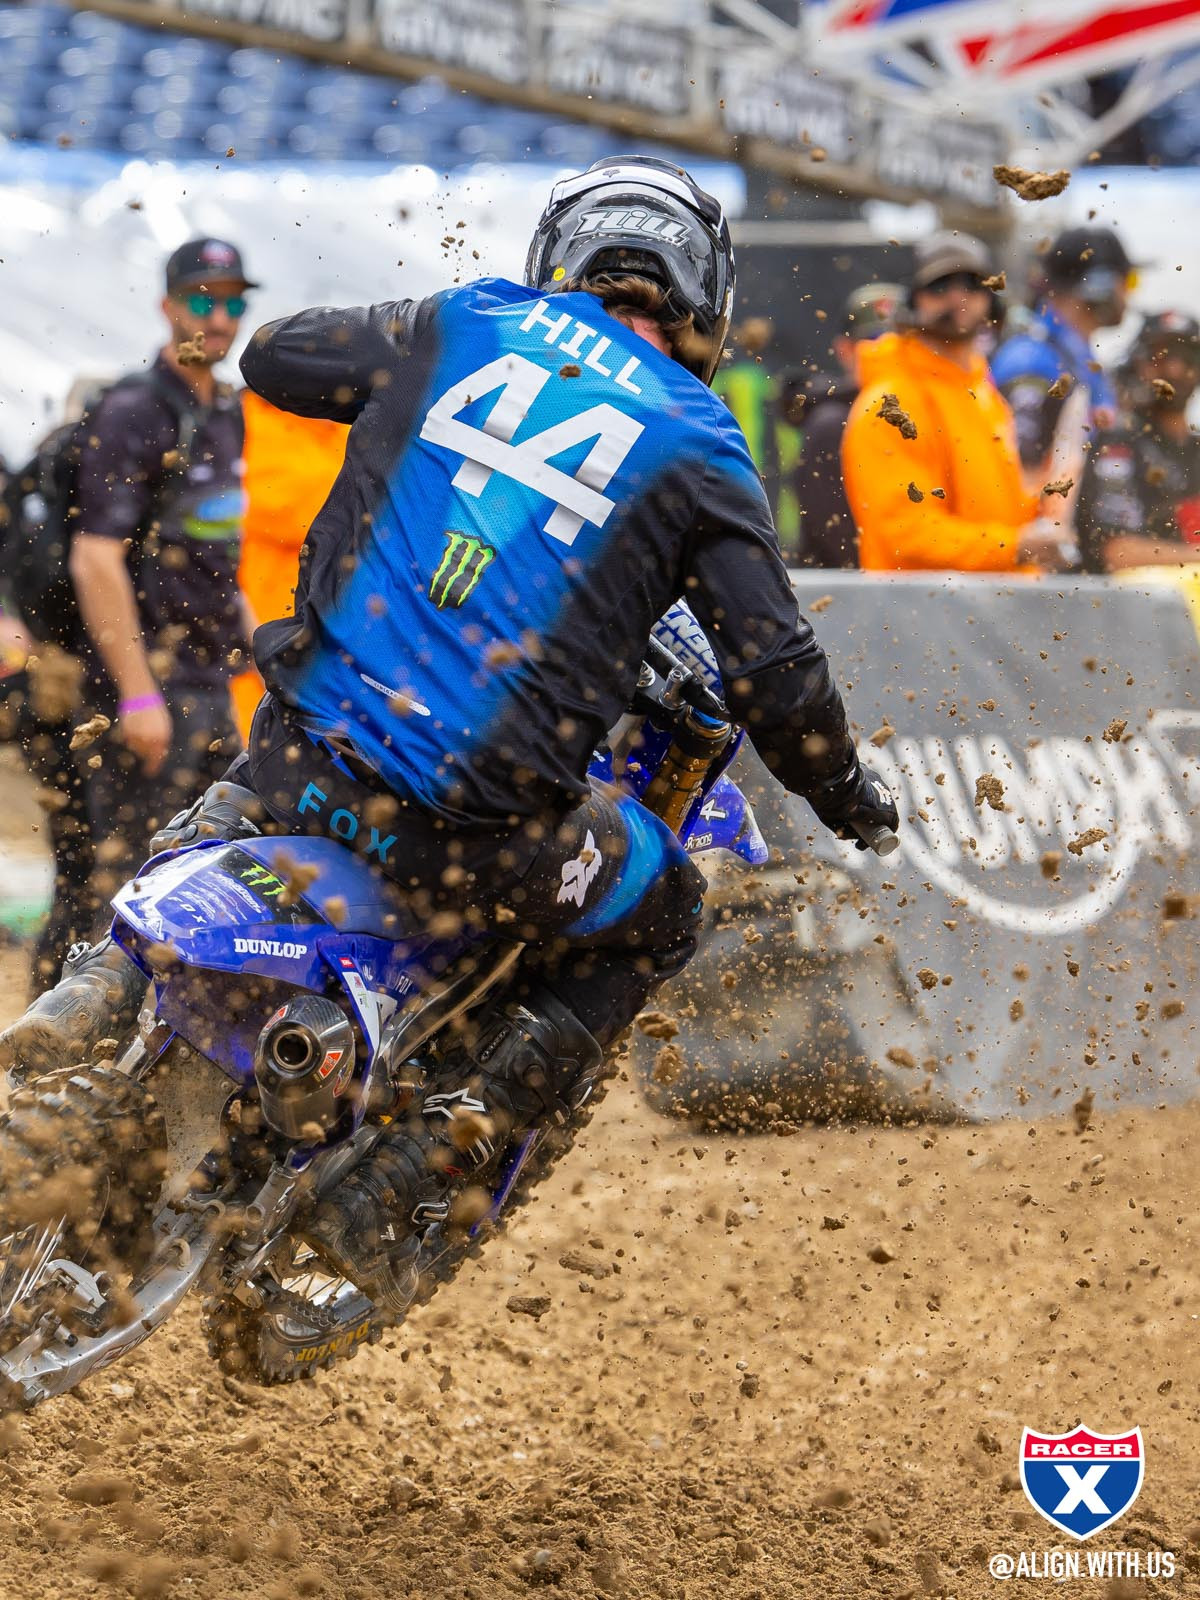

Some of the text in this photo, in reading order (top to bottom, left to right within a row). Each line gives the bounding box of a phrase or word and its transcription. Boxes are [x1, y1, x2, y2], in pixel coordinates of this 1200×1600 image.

[519, 299, 642, 395] HILL
[420, 353, 645, 545] 44
[297, 782, 400, 864] FOX
[234, 937, 308, 960] DUNLOP
